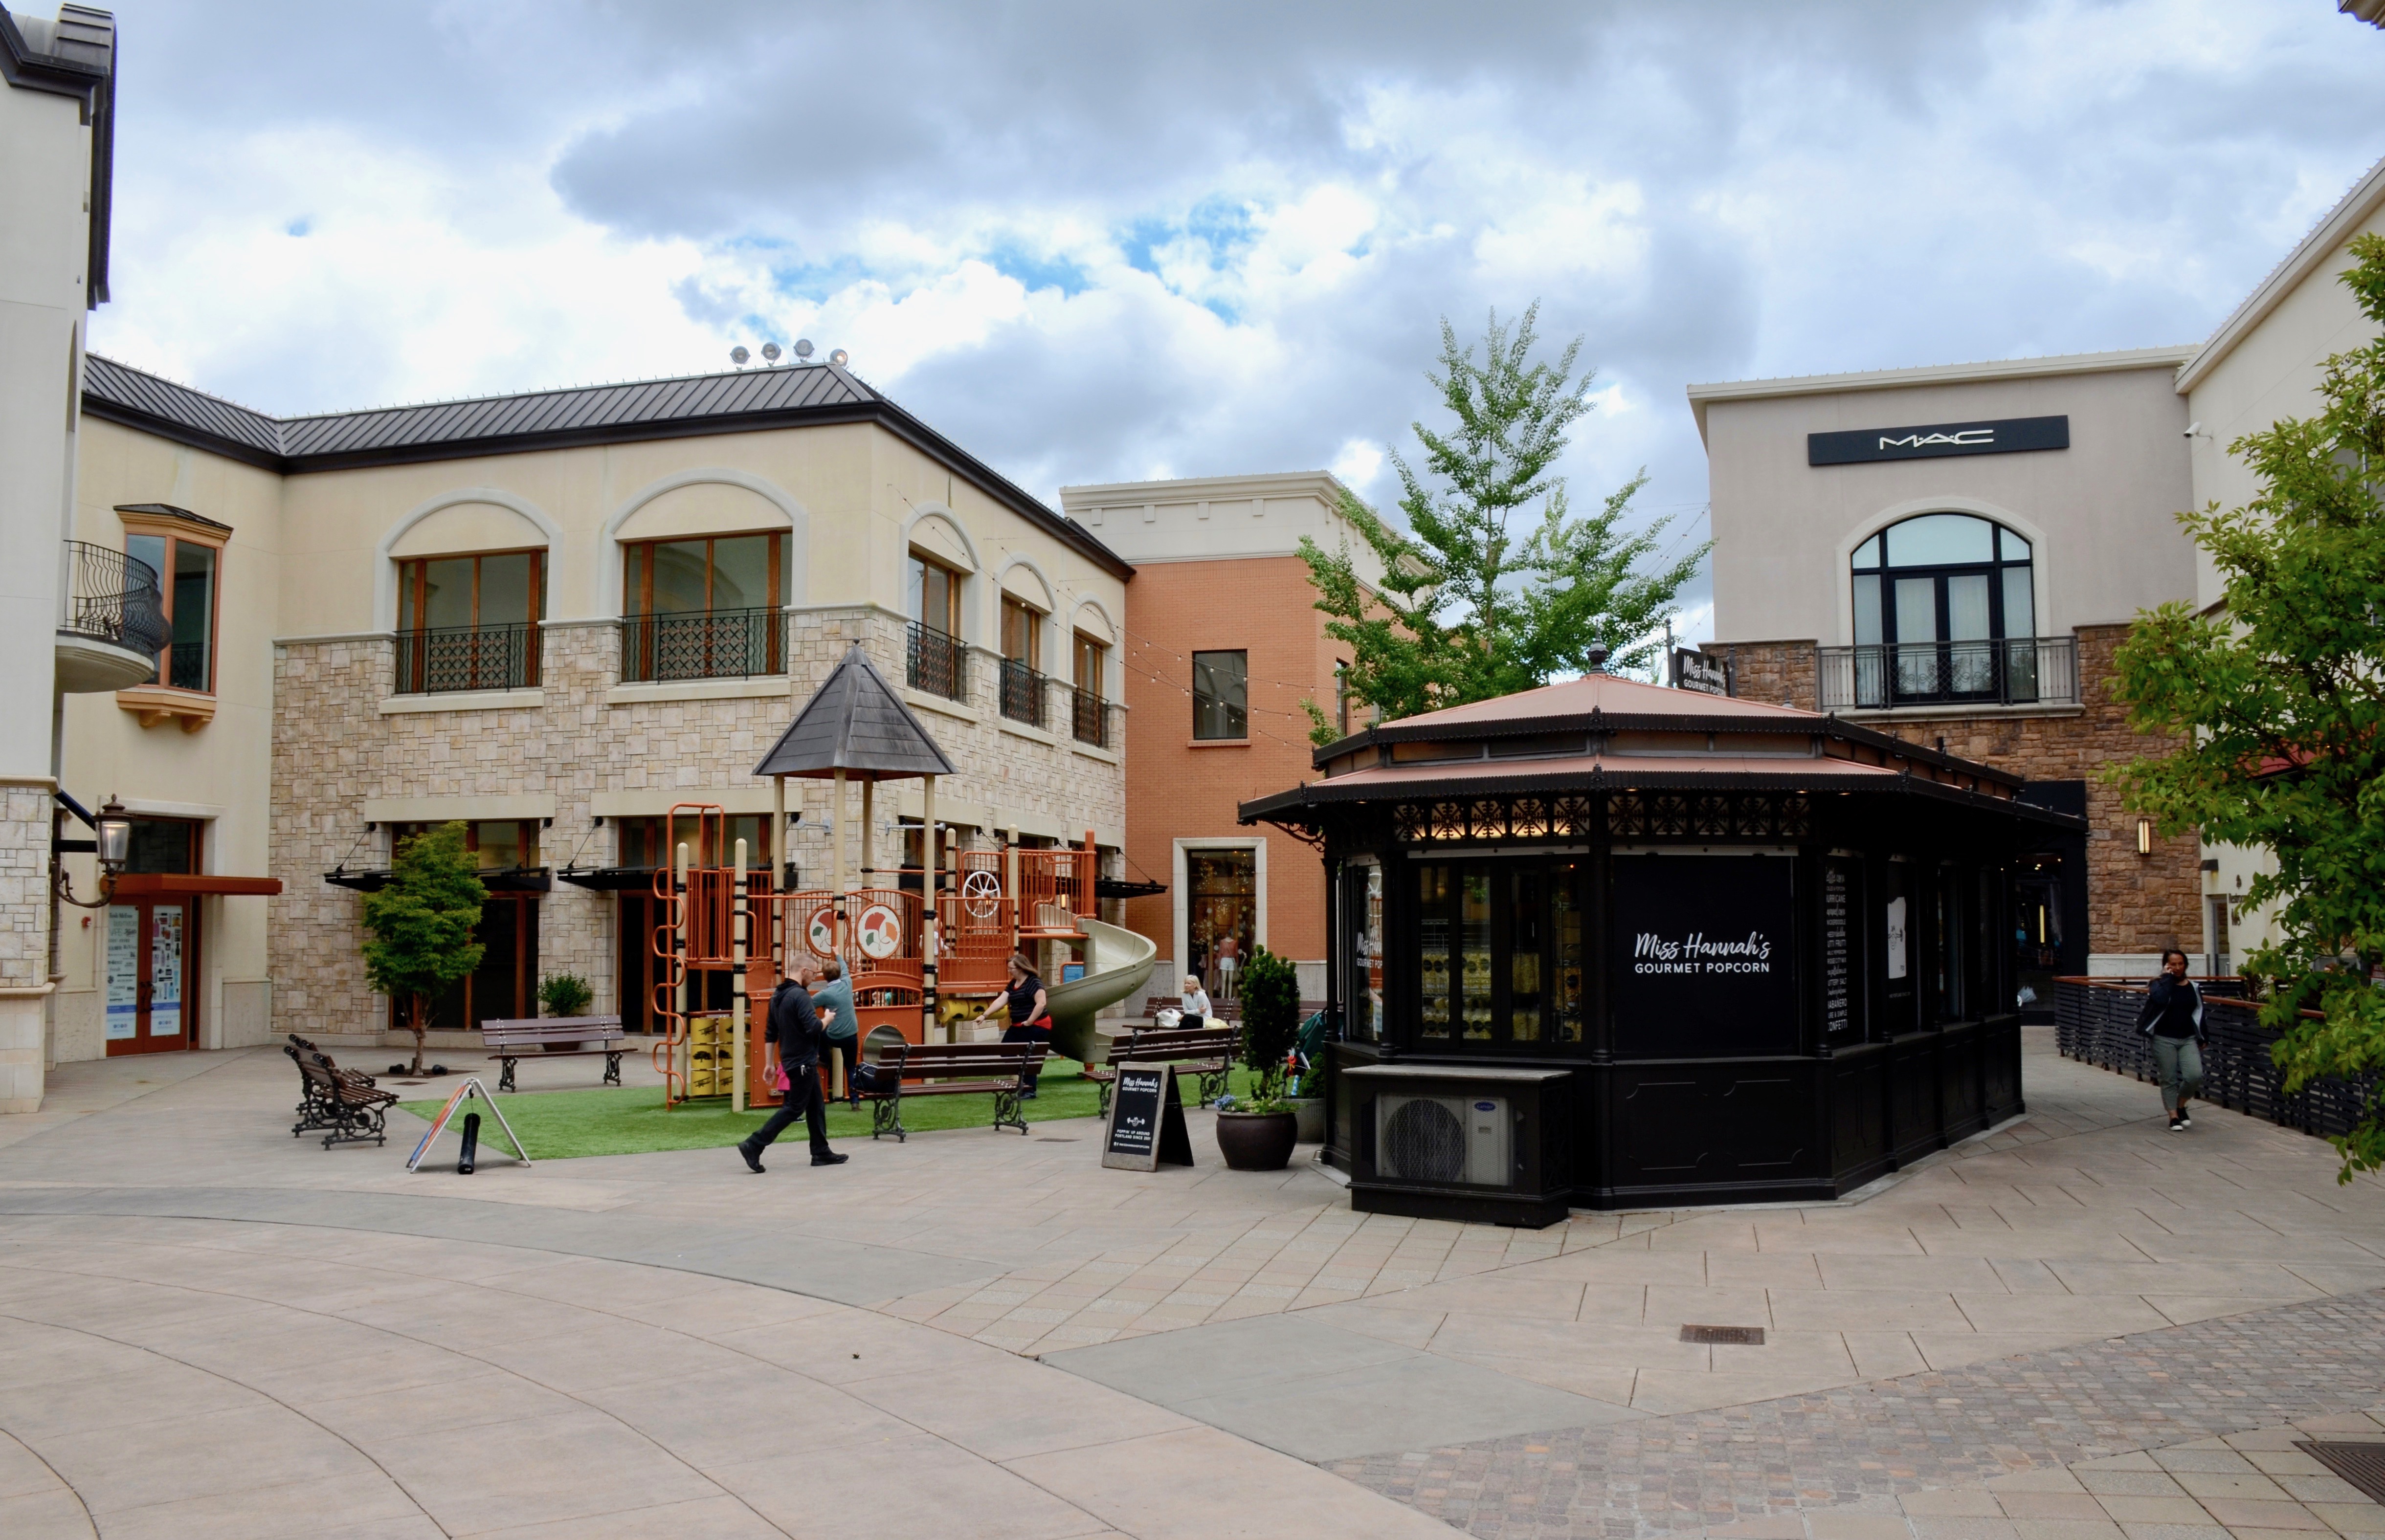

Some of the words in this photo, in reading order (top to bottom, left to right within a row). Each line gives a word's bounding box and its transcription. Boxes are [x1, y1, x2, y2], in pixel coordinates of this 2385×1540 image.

[1683, 655, 1701, 679] Miss
[1684, 679, 1709, 692] GOURMET
[1357, 932, 1369, 955] Miss
[1635, 933, 1680, 960] Miss
[1683, 931, 1771, 959] Hannah's
[1357, 958, 1374, 968] GOURMET
[1635, 963, 1700, 973] GOURMET
[1707, 963, 1769, 973] POPCORN
[1123, 1077, 1135, 1087] Miss
